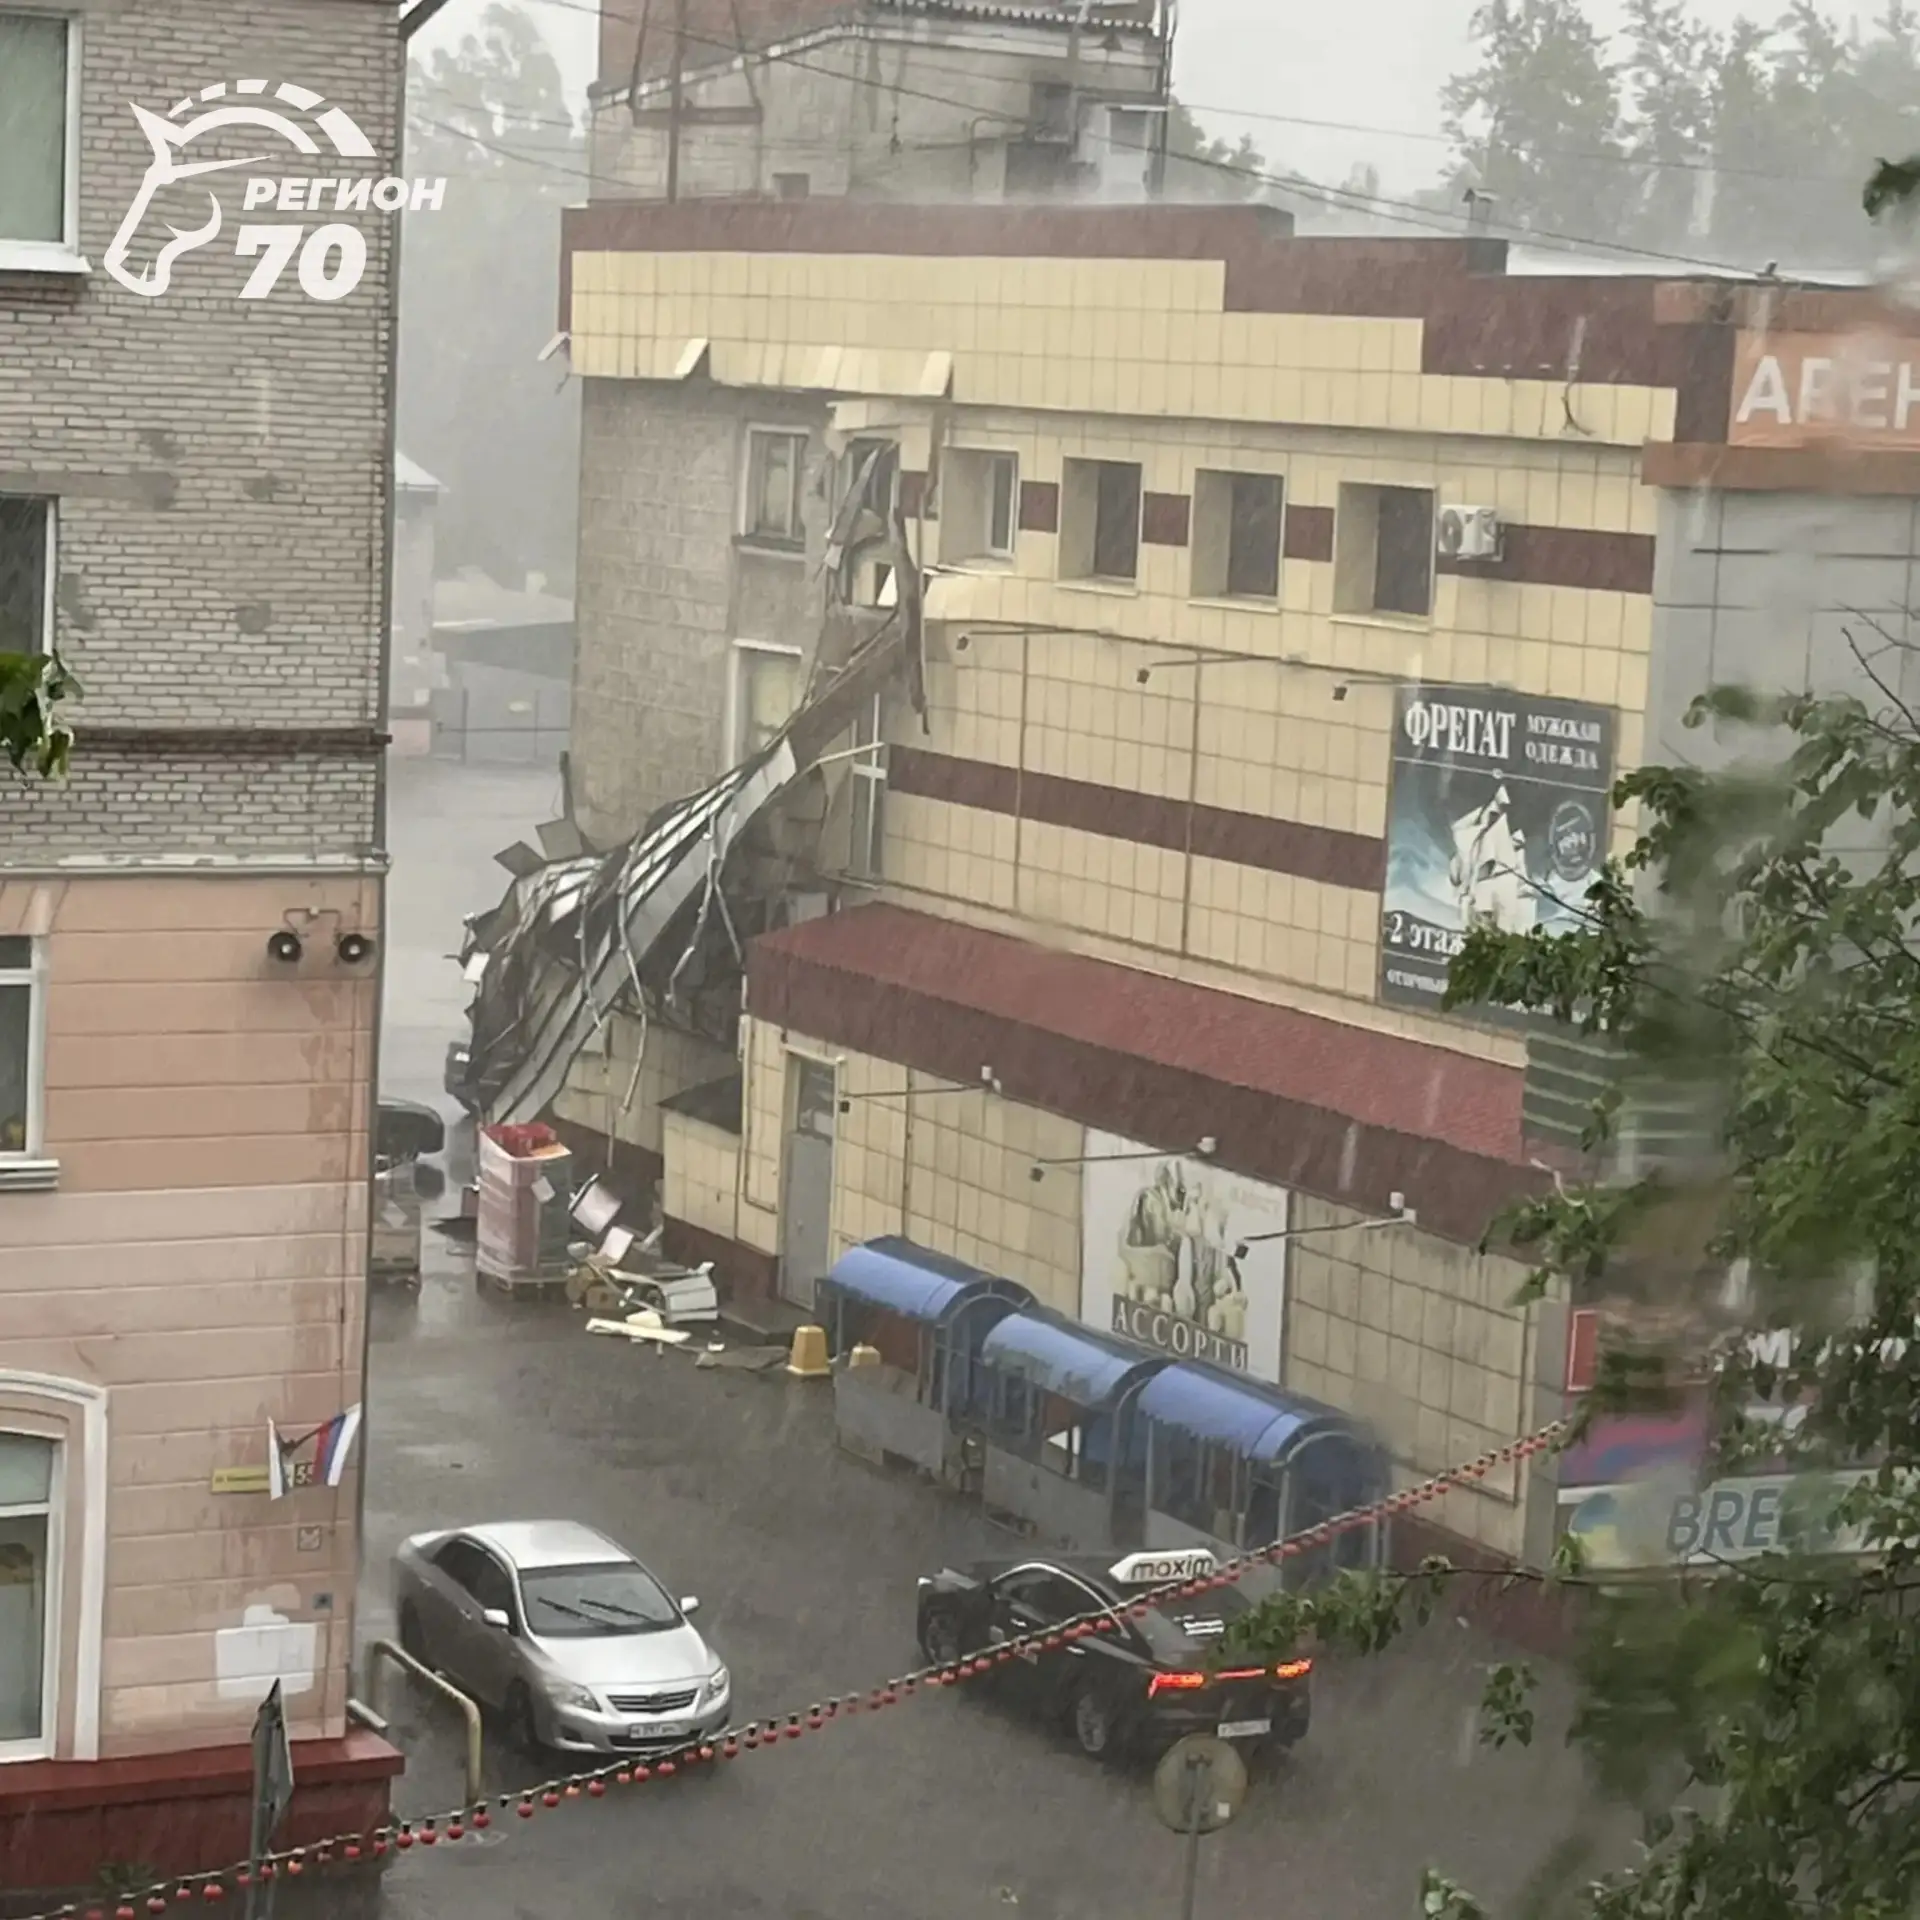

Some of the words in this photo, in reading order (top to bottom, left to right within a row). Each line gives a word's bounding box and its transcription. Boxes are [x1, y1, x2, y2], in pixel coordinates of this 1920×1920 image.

[1404, 701, 1517, 760] ФРЕГАТ
[1524, 740, 1600, 770] ОДЕЖДА
[1388, 912, 1404, 944] 2
[1114, 1300, 1247, 1373] АССОРТИ
[1131, 1553, 1214, 1580] maxim
